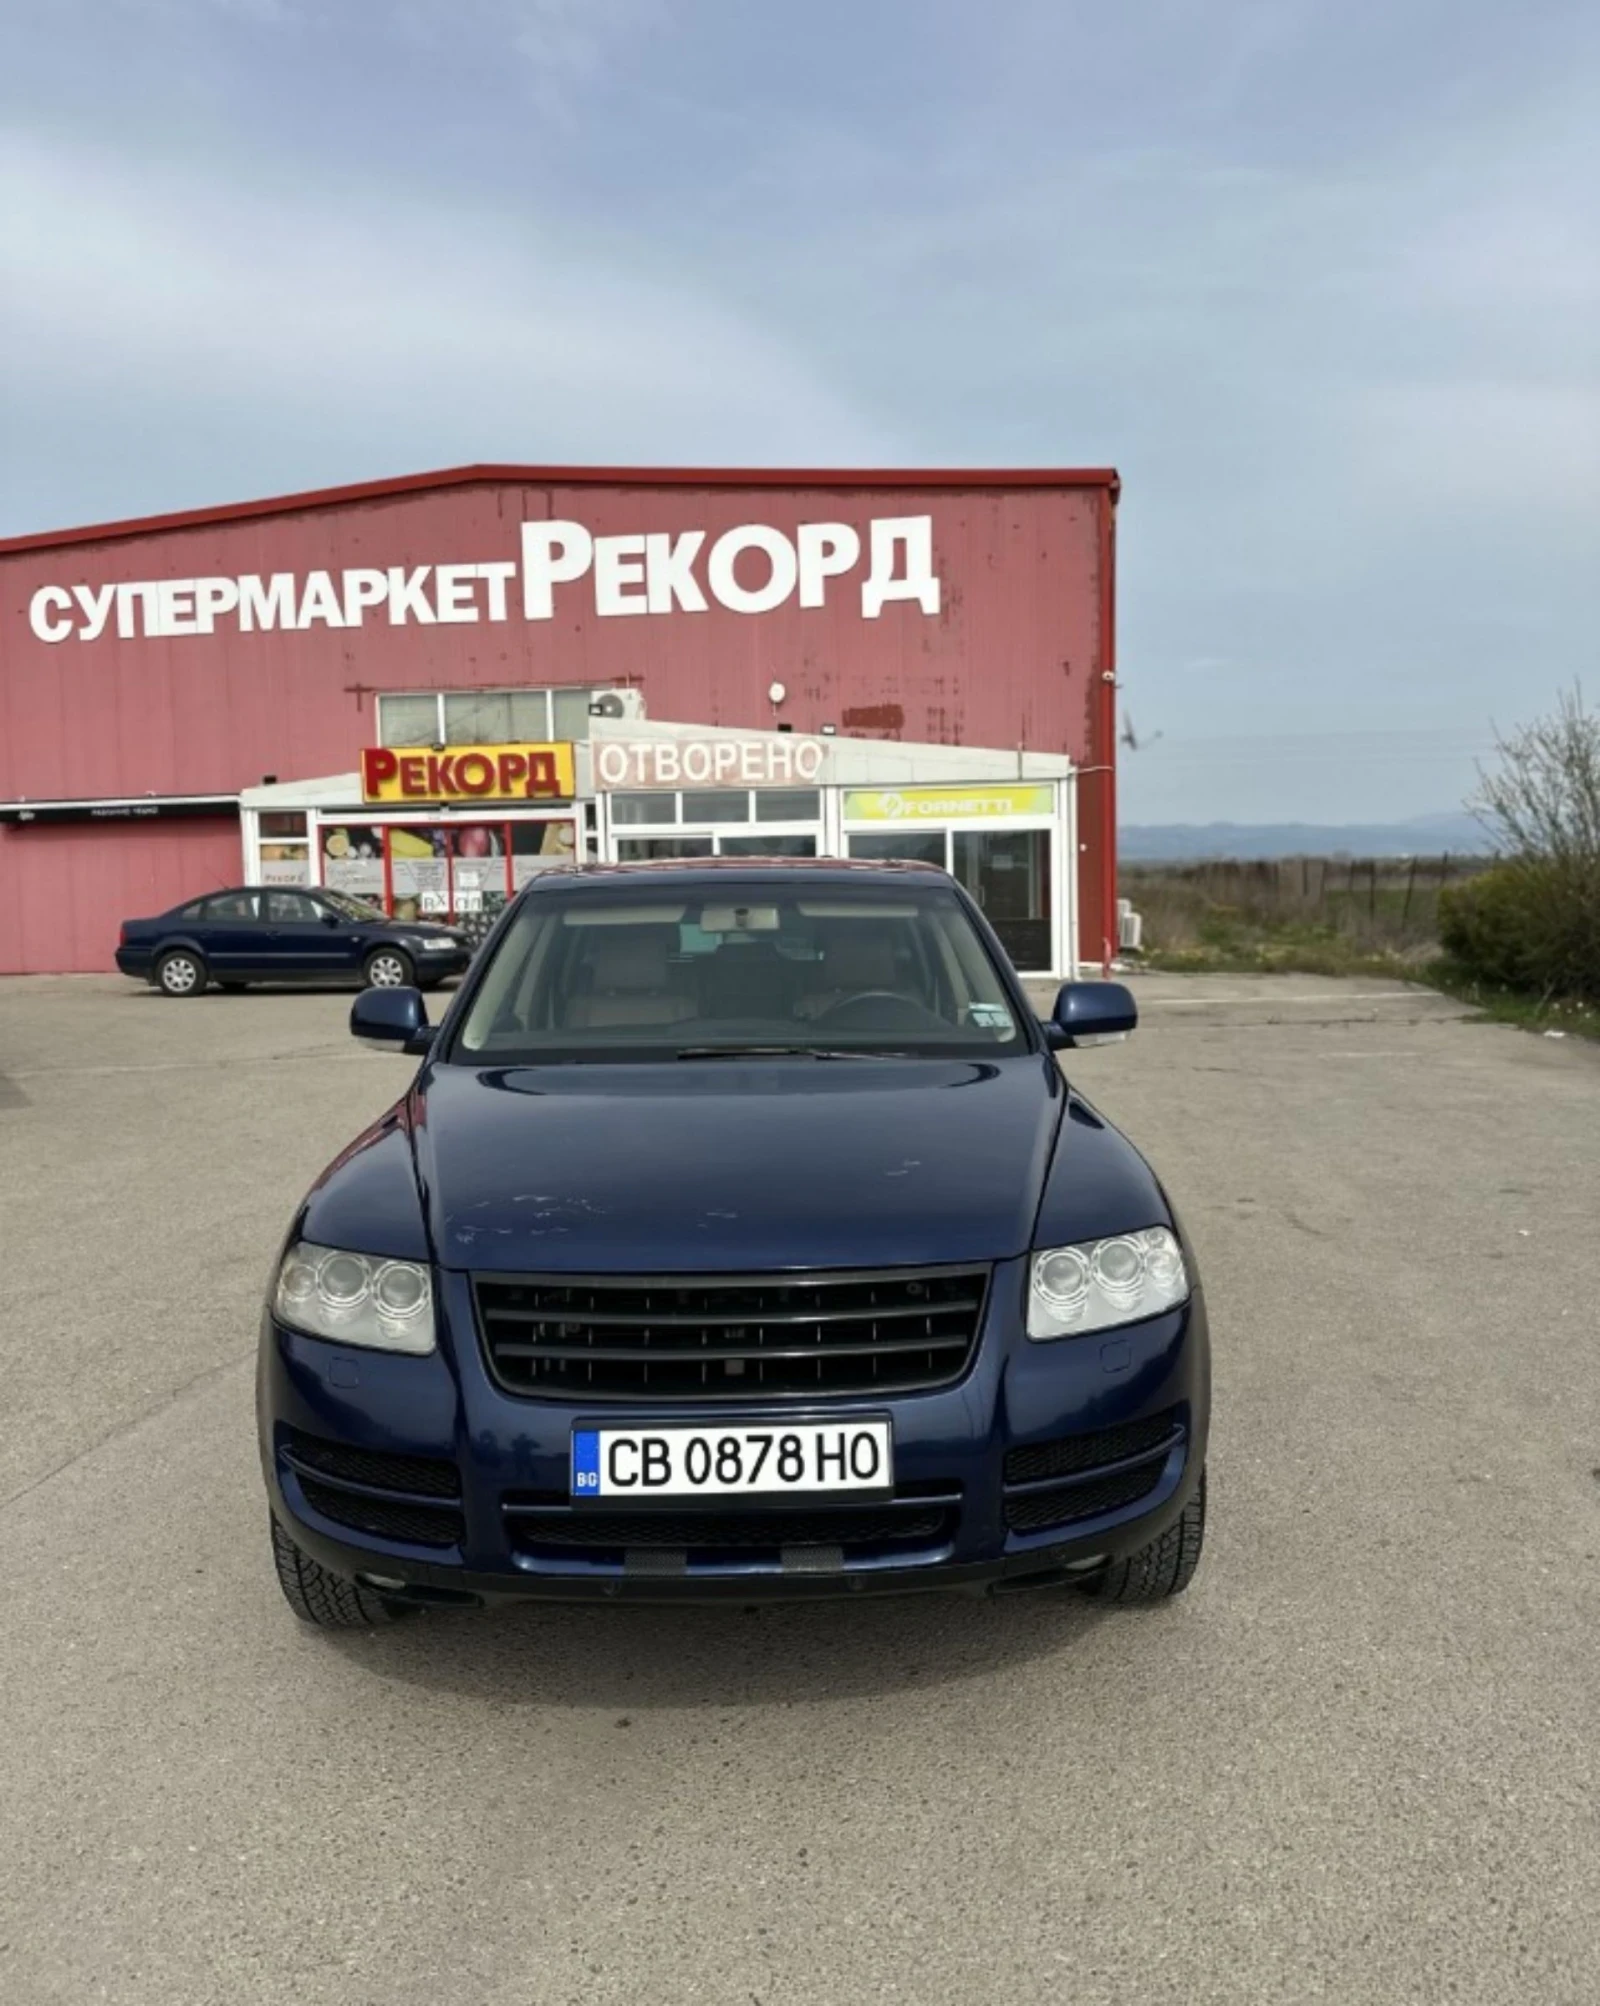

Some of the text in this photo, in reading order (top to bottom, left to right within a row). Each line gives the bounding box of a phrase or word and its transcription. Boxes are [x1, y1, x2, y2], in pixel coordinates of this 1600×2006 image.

[29, 515, 940, 643] СУПЕРМАРКЕТ РЕКОРД
[364, 747, 561, 797] РЕКОРД
[600, 739, 823, 783] ОТВОРЕНО
[577, 1472, 597, 1487] BG
[608, 1438, 672, 1487] CB
[684, 1434, 805, 1485] 0878
